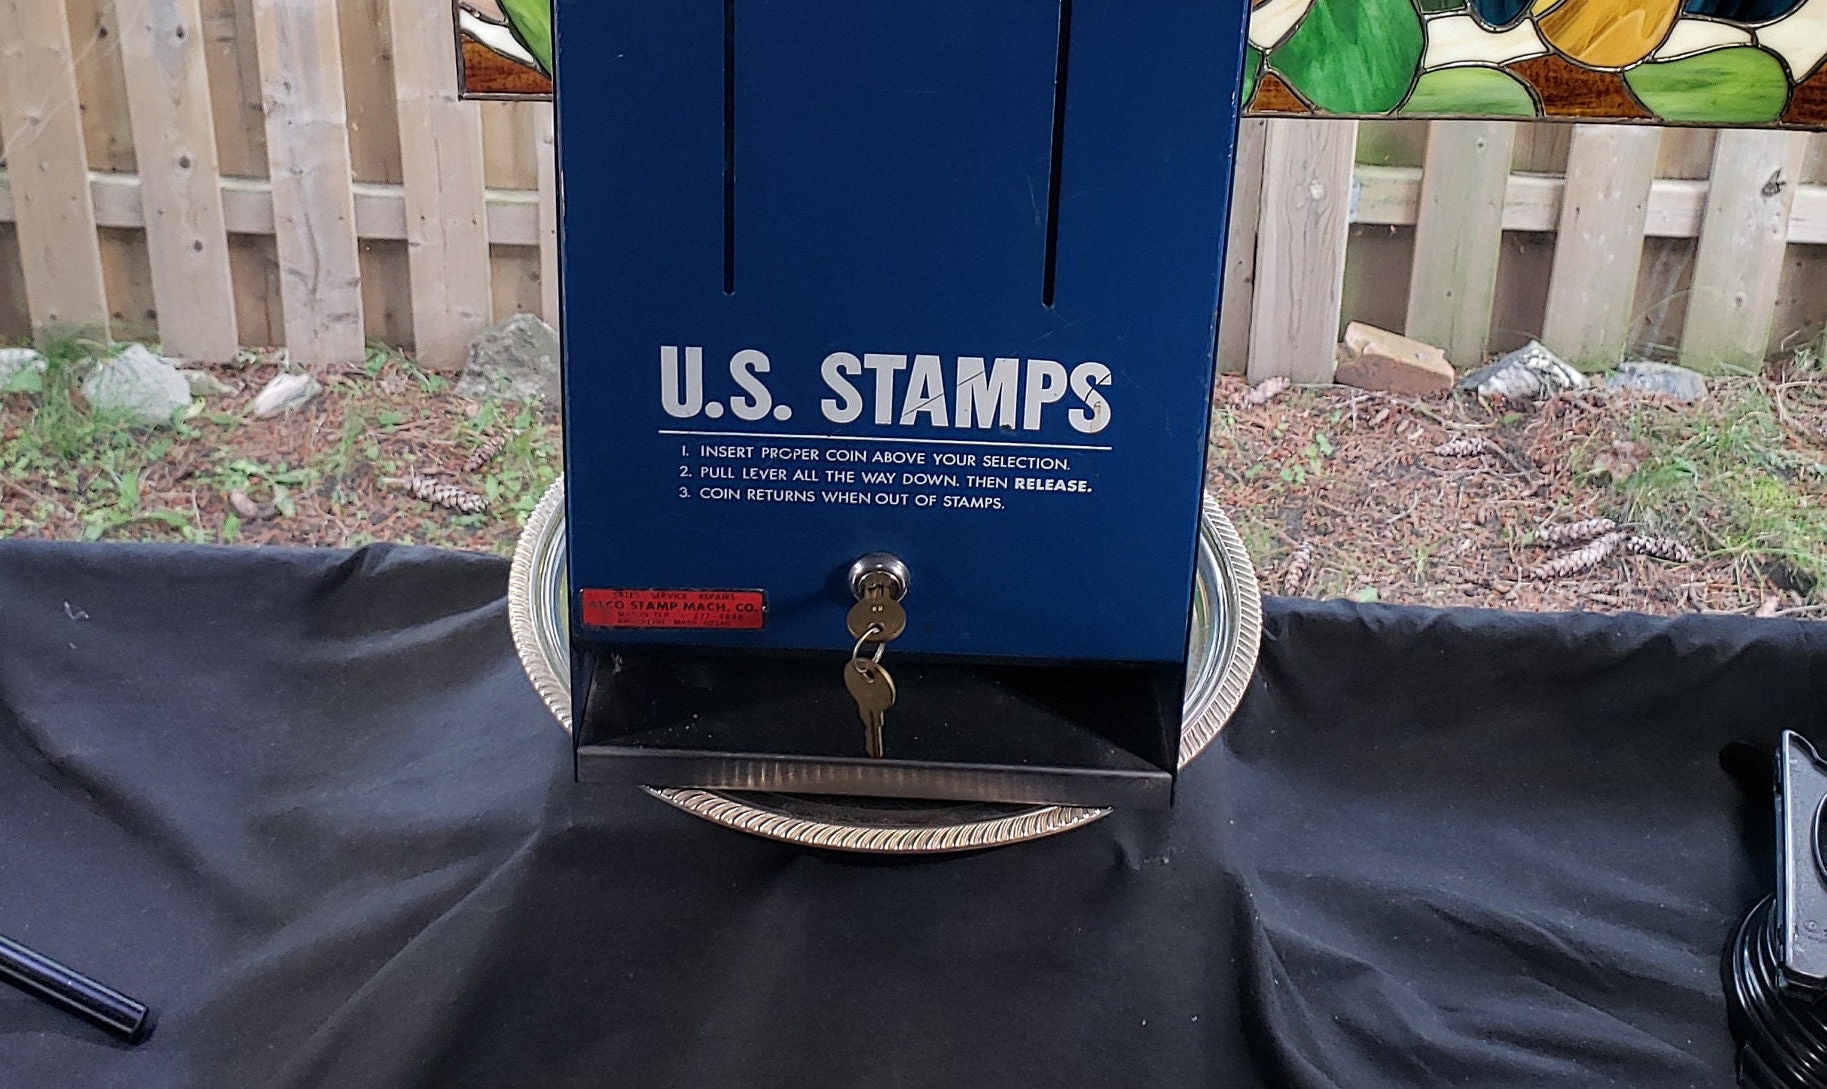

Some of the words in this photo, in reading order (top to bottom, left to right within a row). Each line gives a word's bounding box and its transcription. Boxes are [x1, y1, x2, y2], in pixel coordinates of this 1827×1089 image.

[659, 345, 793, 421] U.S.
[820, 351, 1113, 434] STAMPS
[682, 445, 690, 457] 1.
[701, 445, 754, 458] INSERT
[761, 447, 819, 460] PROPER
[825, 449, 867, 462] COIN
[871, 451, 925, 464] ABOVE
[933, 453, 976, 466] YOUR
[982, 455, 1070, 470] SELECTION.
[679, 466, 692, 477] 2.
[701, 467, 735, 479] PULL
[742, 468, 787, 481] LEVER
[792, 469, 819, 482] ALL
[825, 470, 855, 483] THE
[861, 472, 896, 485] WAY
[902, 473, 960, 487] DOWN.
[967, 475, 1008, 489] THEN
[1014, 477, 1092, 493] RELEASE.
[679, 487, 691, 498] 3.
[700, 487, 741, 500] COIN
[747, 489, 816, 502] RETURNS
[821, 491, 871, 505] WHEN
[875, 493, 909, 506] OUT
[915, 495, 937, 507] OF
[943, 495, 1005, 510] STAMPS.
[631, 601, 678, 611] STAMP
[683, 602, 731, 612] MACH.
[736, 603, 759, 613] CO.
[698, 593, 736, 601] REPAIRS
